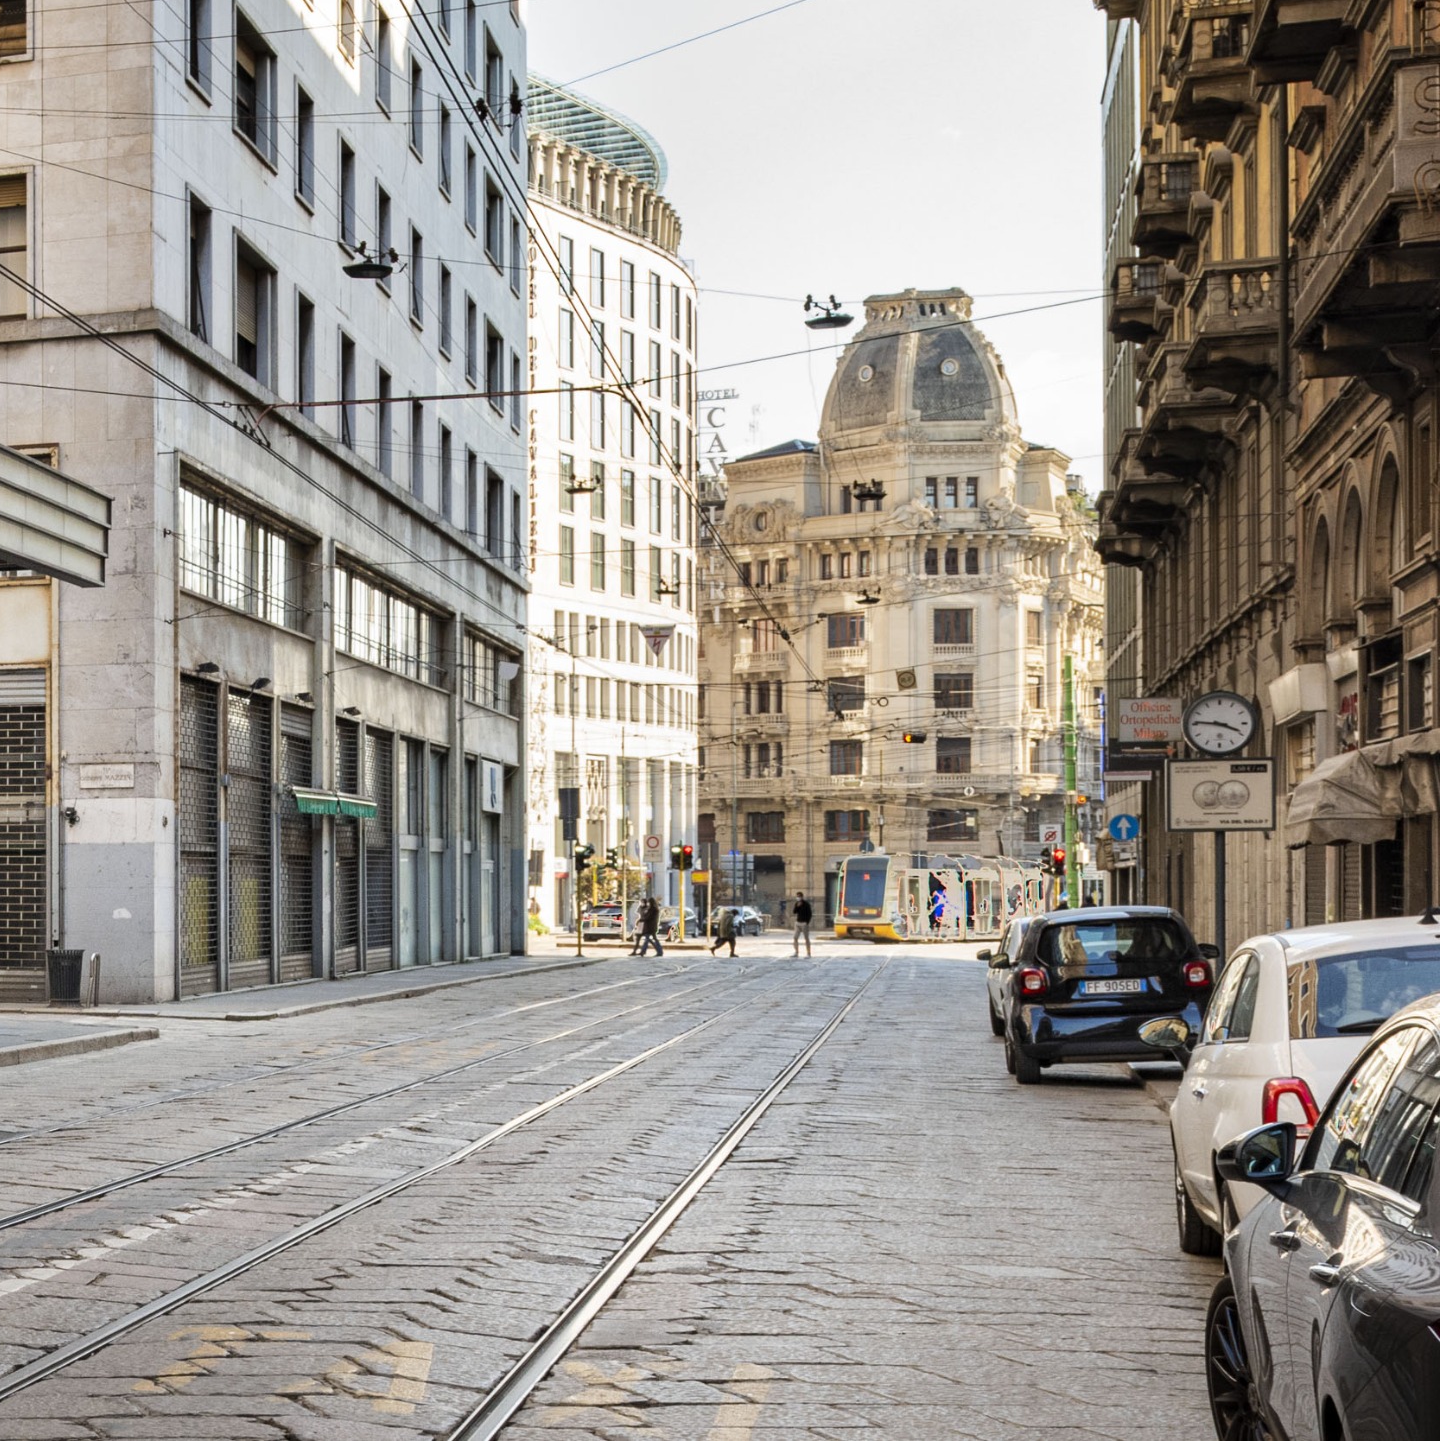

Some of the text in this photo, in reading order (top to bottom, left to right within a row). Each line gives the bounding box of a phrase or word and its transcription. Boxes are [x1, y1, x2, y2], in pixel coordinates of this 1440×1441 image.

[696, 388, 740, 402] HOTEL
[1130, 702, 1172, 712] Officine
[1120, 714, 1182, 726] Ortopediche
[1133, 728, 1169, 739] Milano
[1086, 981, 1139, 992] FF 905ED
